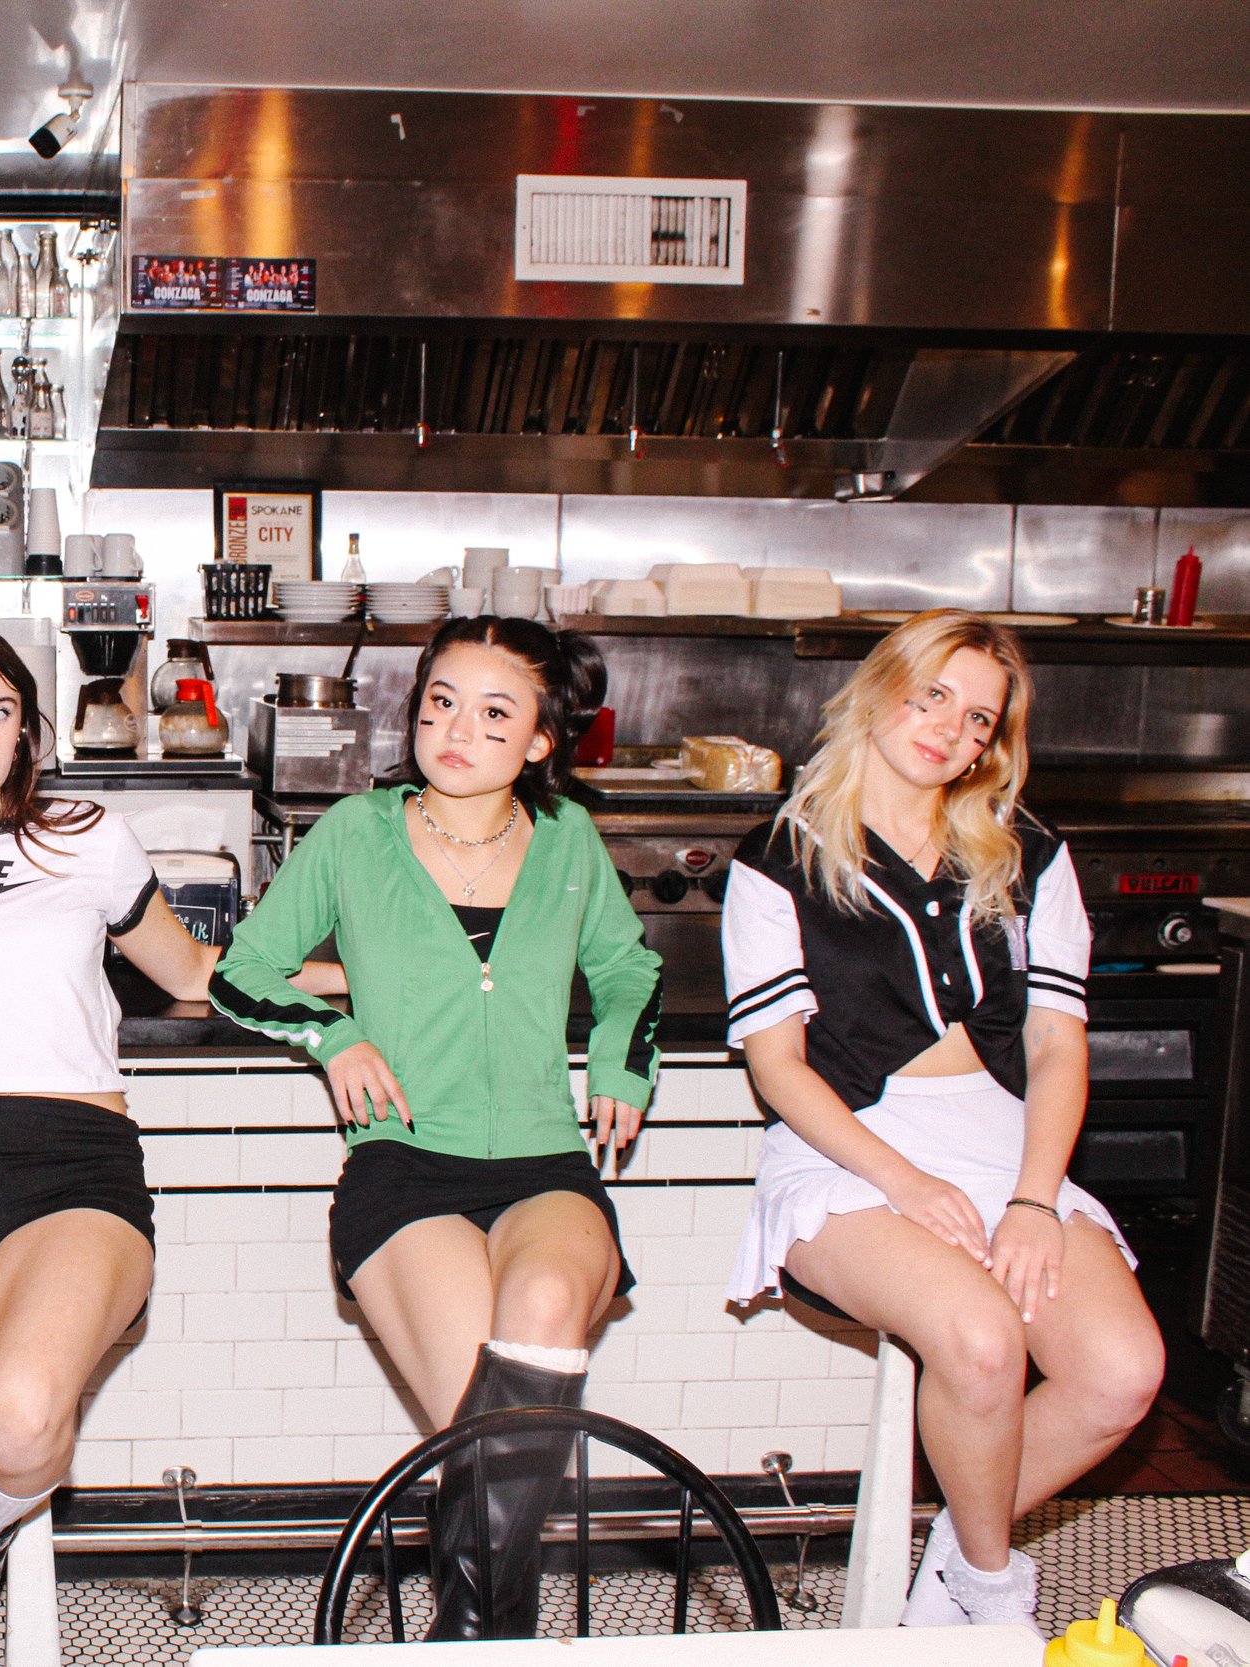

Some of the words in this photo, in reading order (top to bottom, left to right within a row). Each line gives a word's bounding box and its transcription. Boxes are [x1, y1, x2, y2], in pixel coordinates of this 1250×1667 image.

[154, 287, 200, 300] GONZAGA
[246, 289, 293, 302] GONZAGA
[251, 506, 303, 516] SPOKANE
[258, 526, 293, 542] CITY
